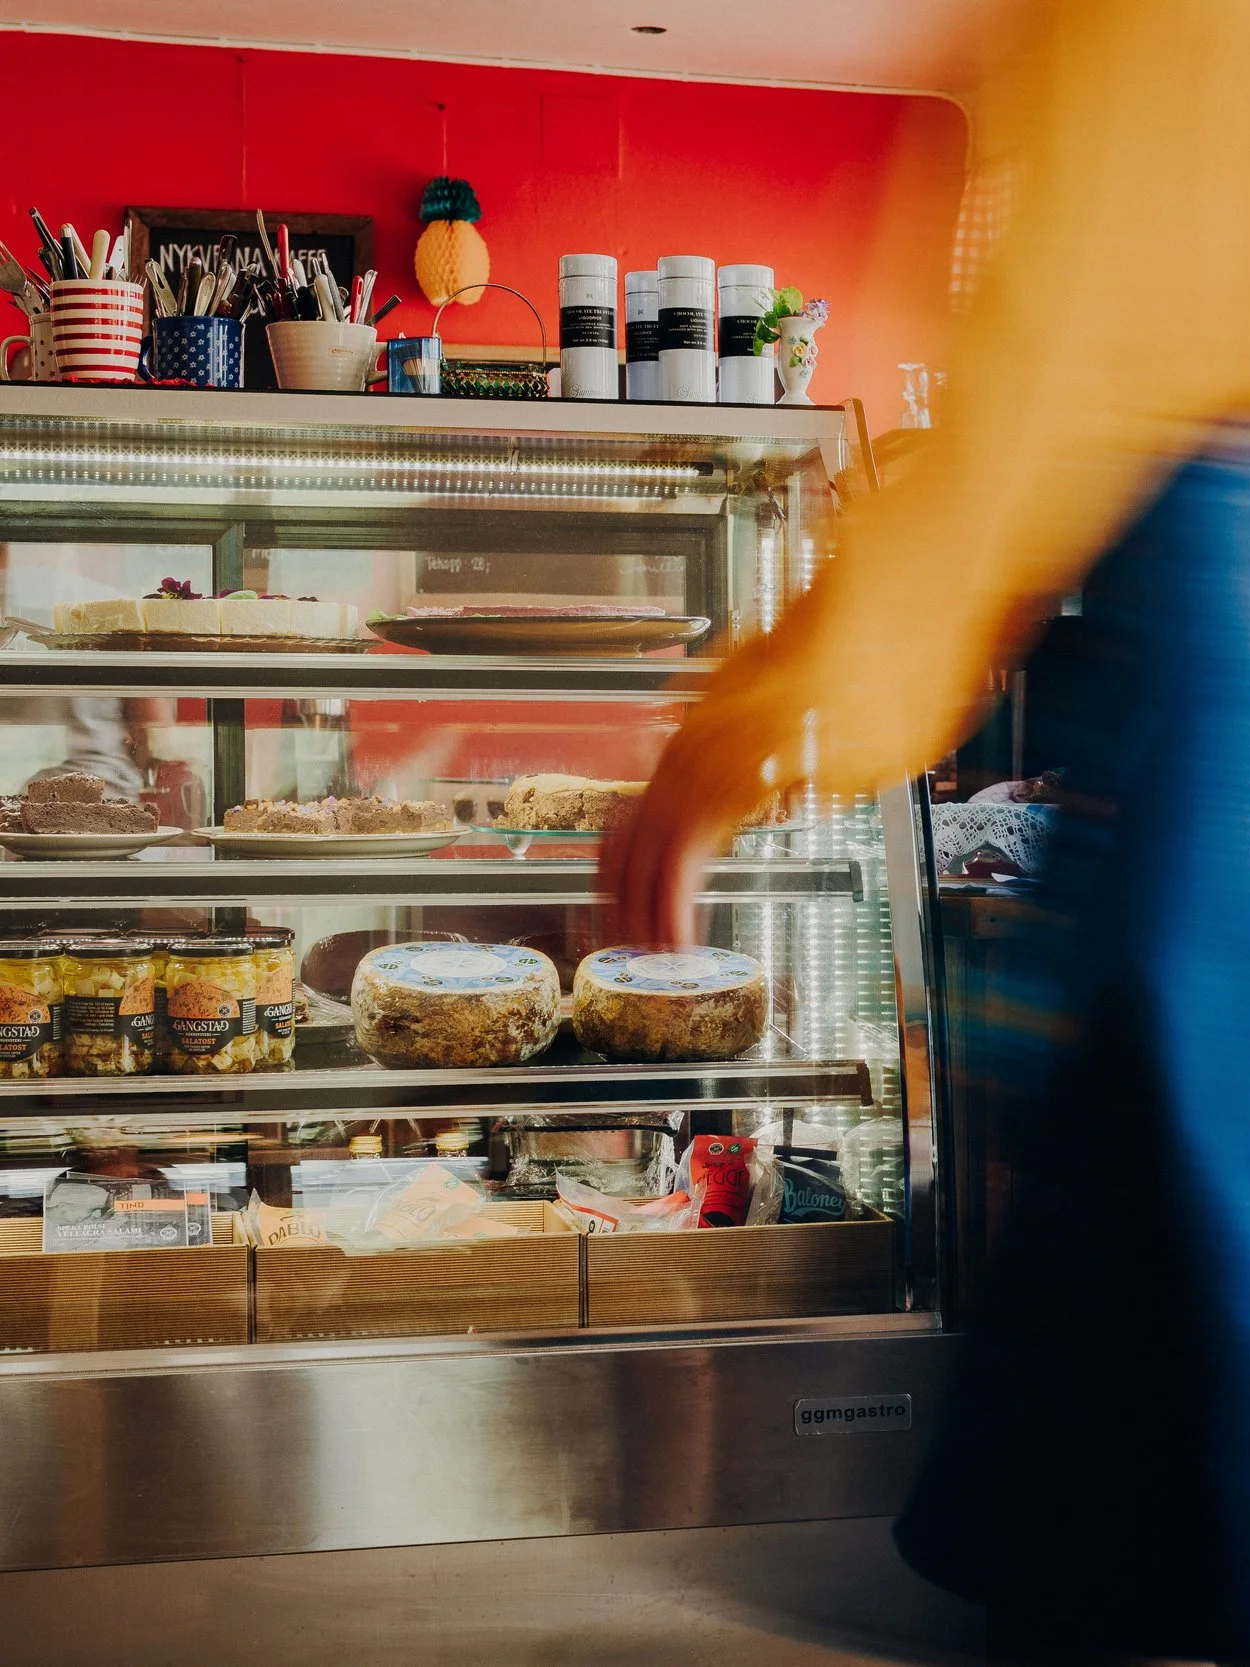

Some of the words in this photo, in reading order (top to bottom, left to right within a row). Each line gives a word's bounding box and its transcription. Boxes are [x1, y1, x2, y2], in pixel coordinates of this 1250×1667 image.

[159, 243, 267, 277] NYKVENA
[172, 1019, 229, 1032] GANGSTAD
[801, 1404, 906, 1424] ggmgastro
